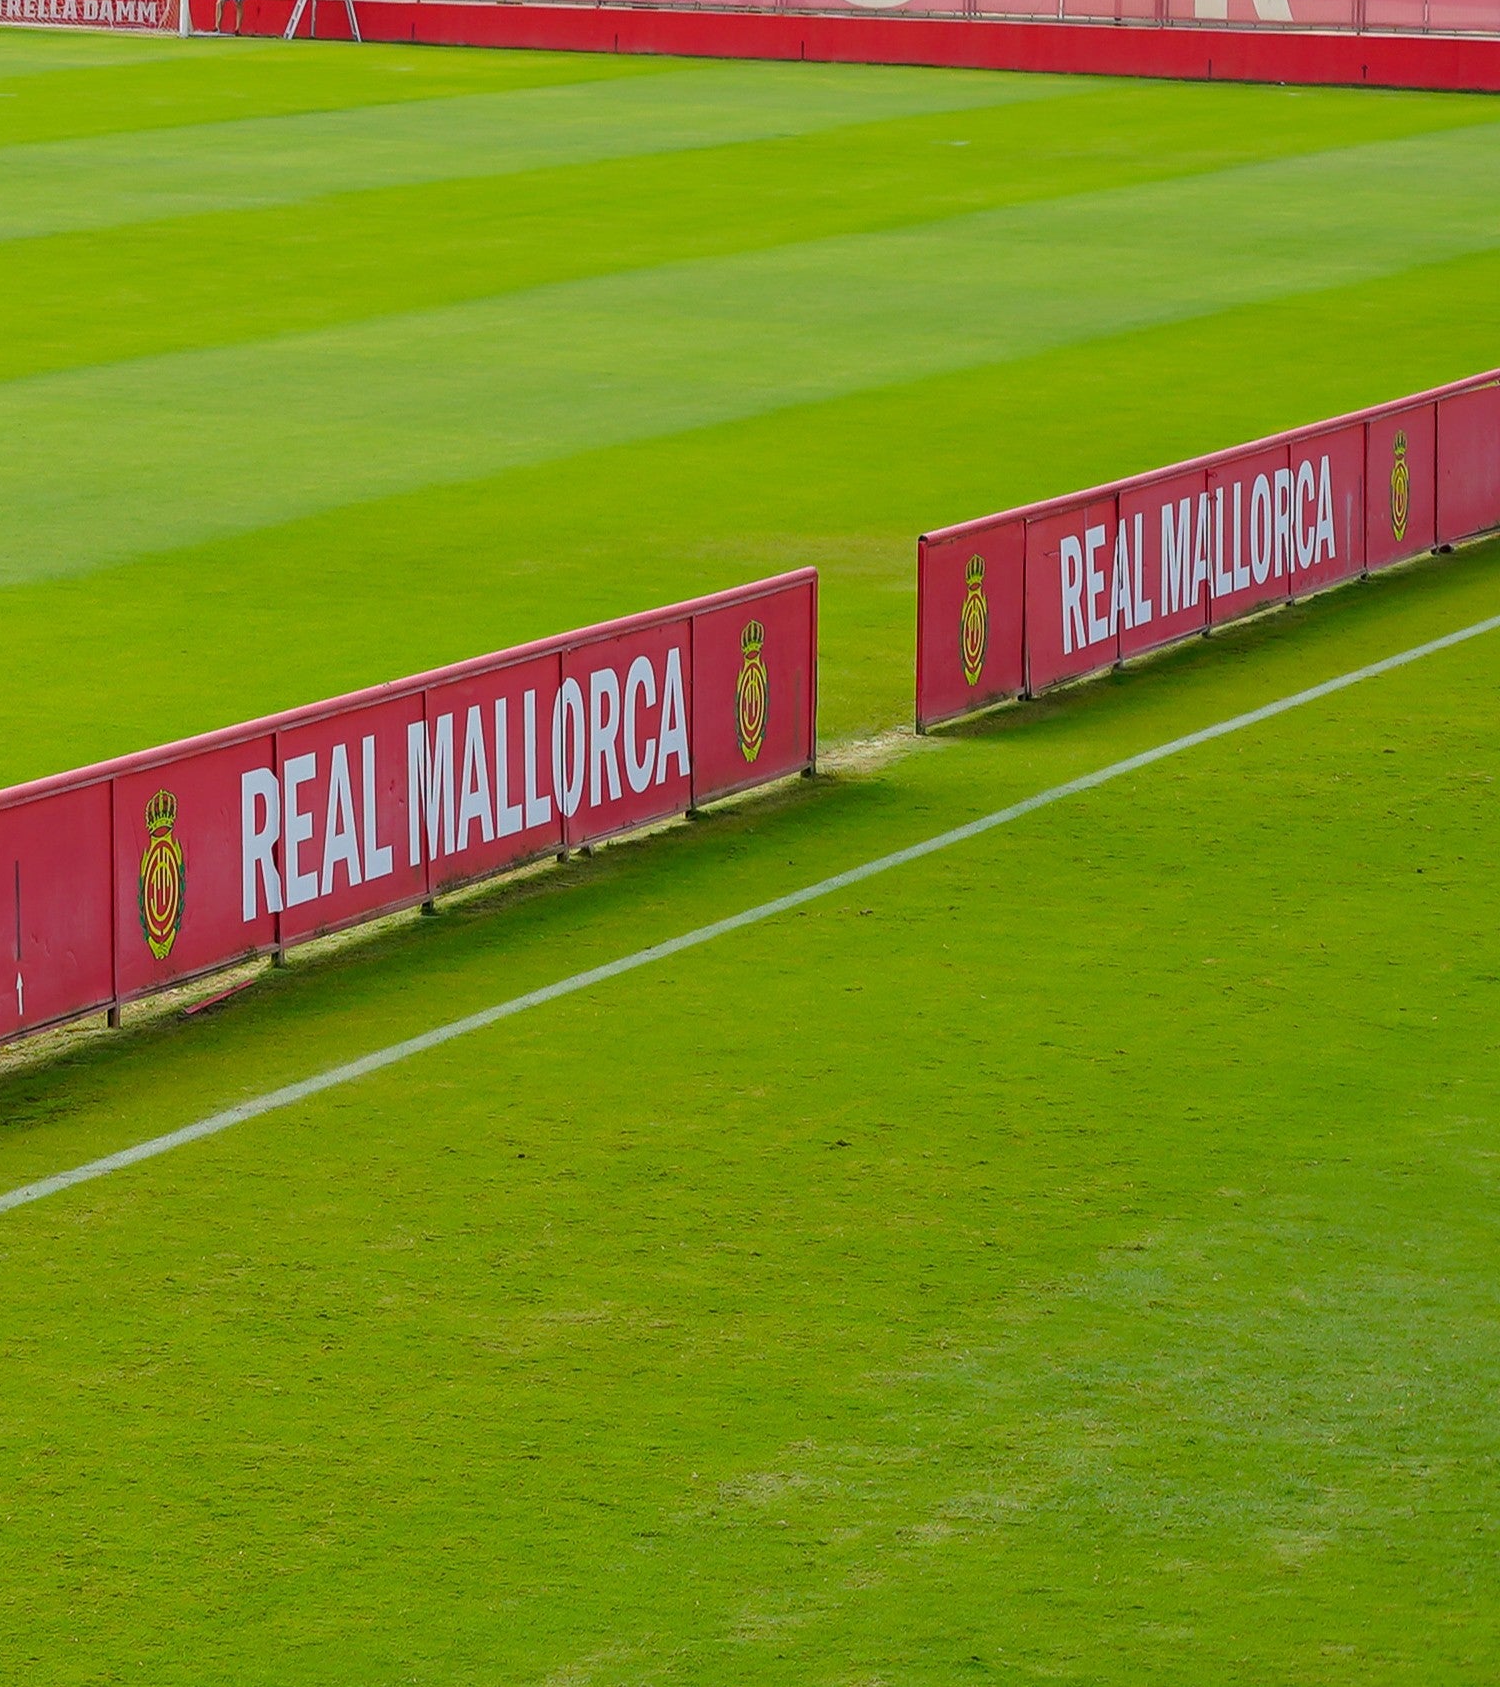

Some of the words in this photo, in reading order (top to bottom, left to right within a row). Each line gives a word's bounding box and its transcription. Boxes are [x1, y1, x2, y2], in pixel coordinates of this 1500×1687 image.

[1060, 513, 1152, 654] REAL
[1161, 455, 1336, 616] MALLORCA
[241, 734, 392, 922] REAL
[407, 648, 690, 866] MALLORCA
